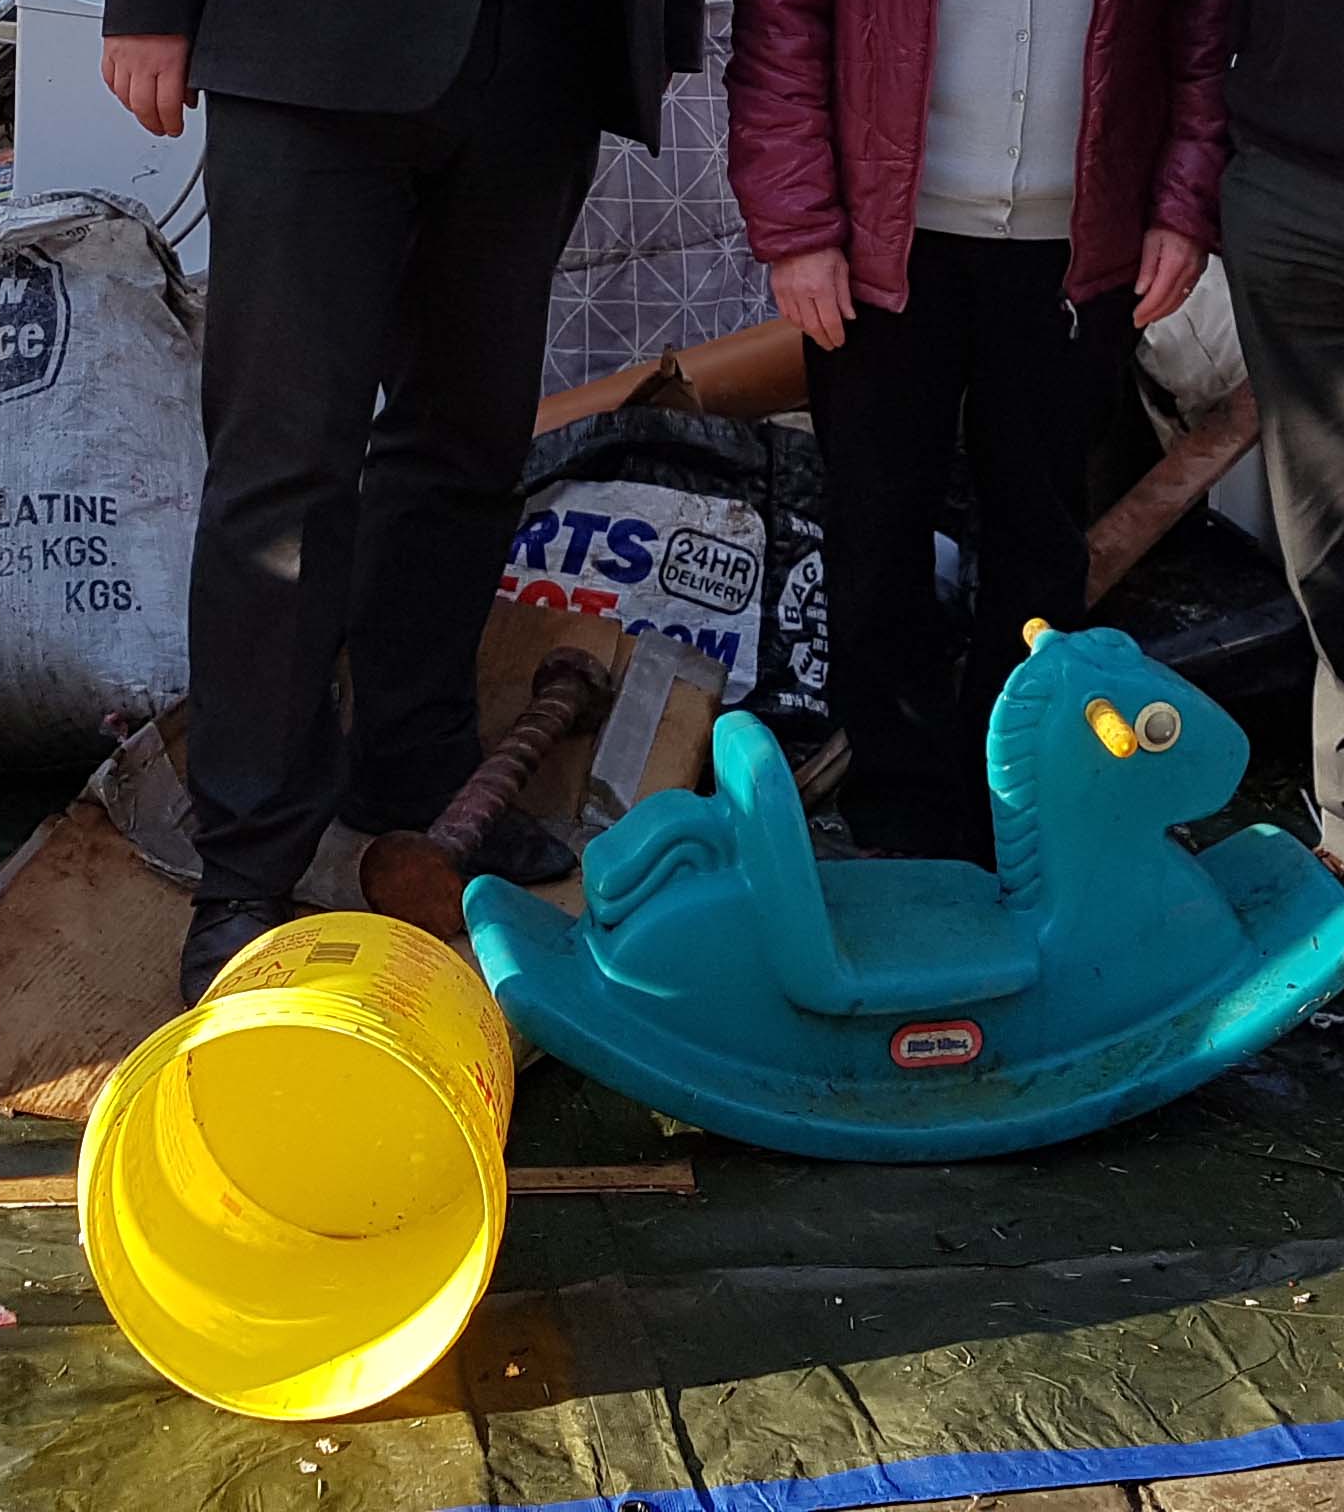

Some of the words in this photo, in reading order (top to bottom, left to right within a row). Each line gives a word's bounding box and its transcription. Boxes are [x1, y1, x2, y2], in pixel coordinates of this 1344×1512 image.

[42, 535, 117, 571] KGS.
[674, 539, 753, 585] 24HR
[65, 579, 143, 615] KGS.
[664, 565, 747, 605] DELIVERY
